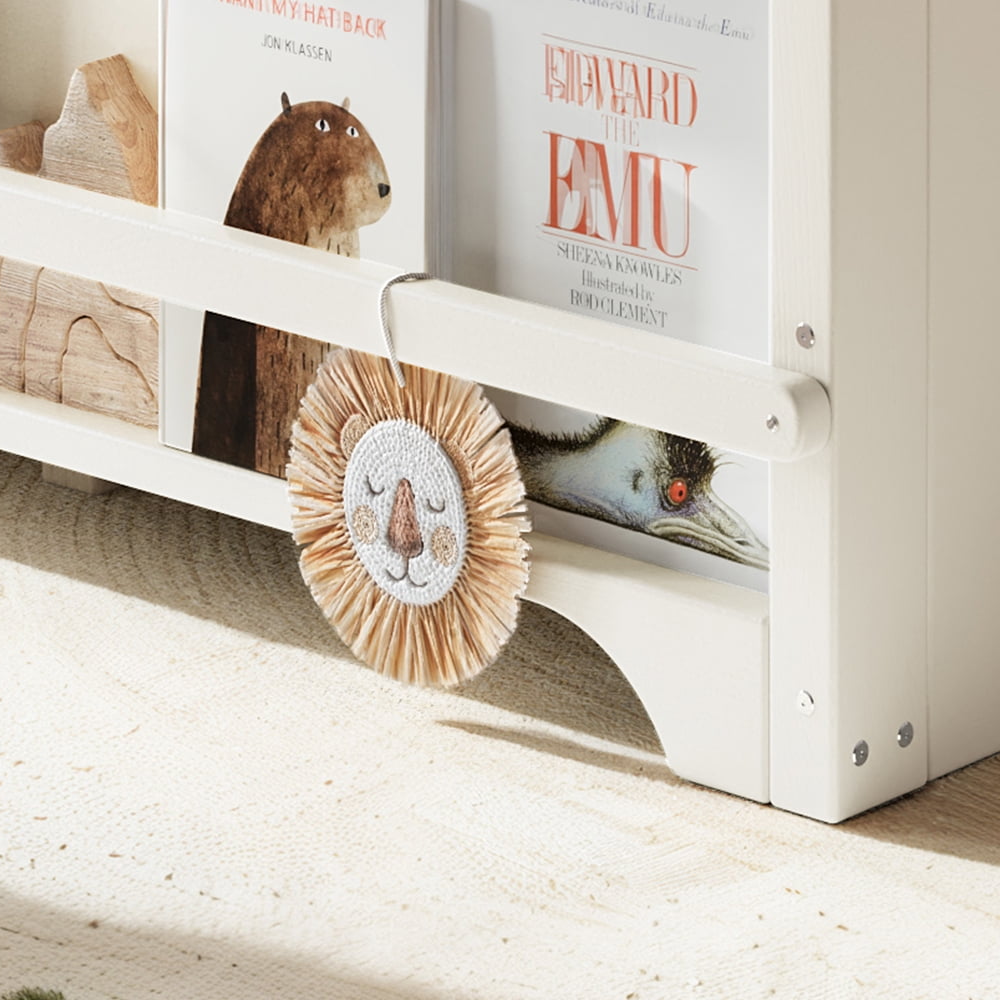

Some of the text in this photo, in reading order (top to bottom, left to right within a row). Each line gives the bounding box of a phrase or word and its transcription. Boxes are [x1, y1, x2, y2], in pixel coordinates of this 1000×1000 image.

[304, 2, 336, 28] HAT
[343, 11, 387, 40] BACK
[261, 34, 333, 62] JON KLASSEN
[543, 43, 698, 128] EDWARD
[601, 113, 640, 147] THE
[541, 131, 698, 258] EMU
[556, 241, 683, 286] SHEENA KNOWLES
[581, 269, 639, 299] Illustrated
[570, 289, 668, 328] ROD CLEMENT
